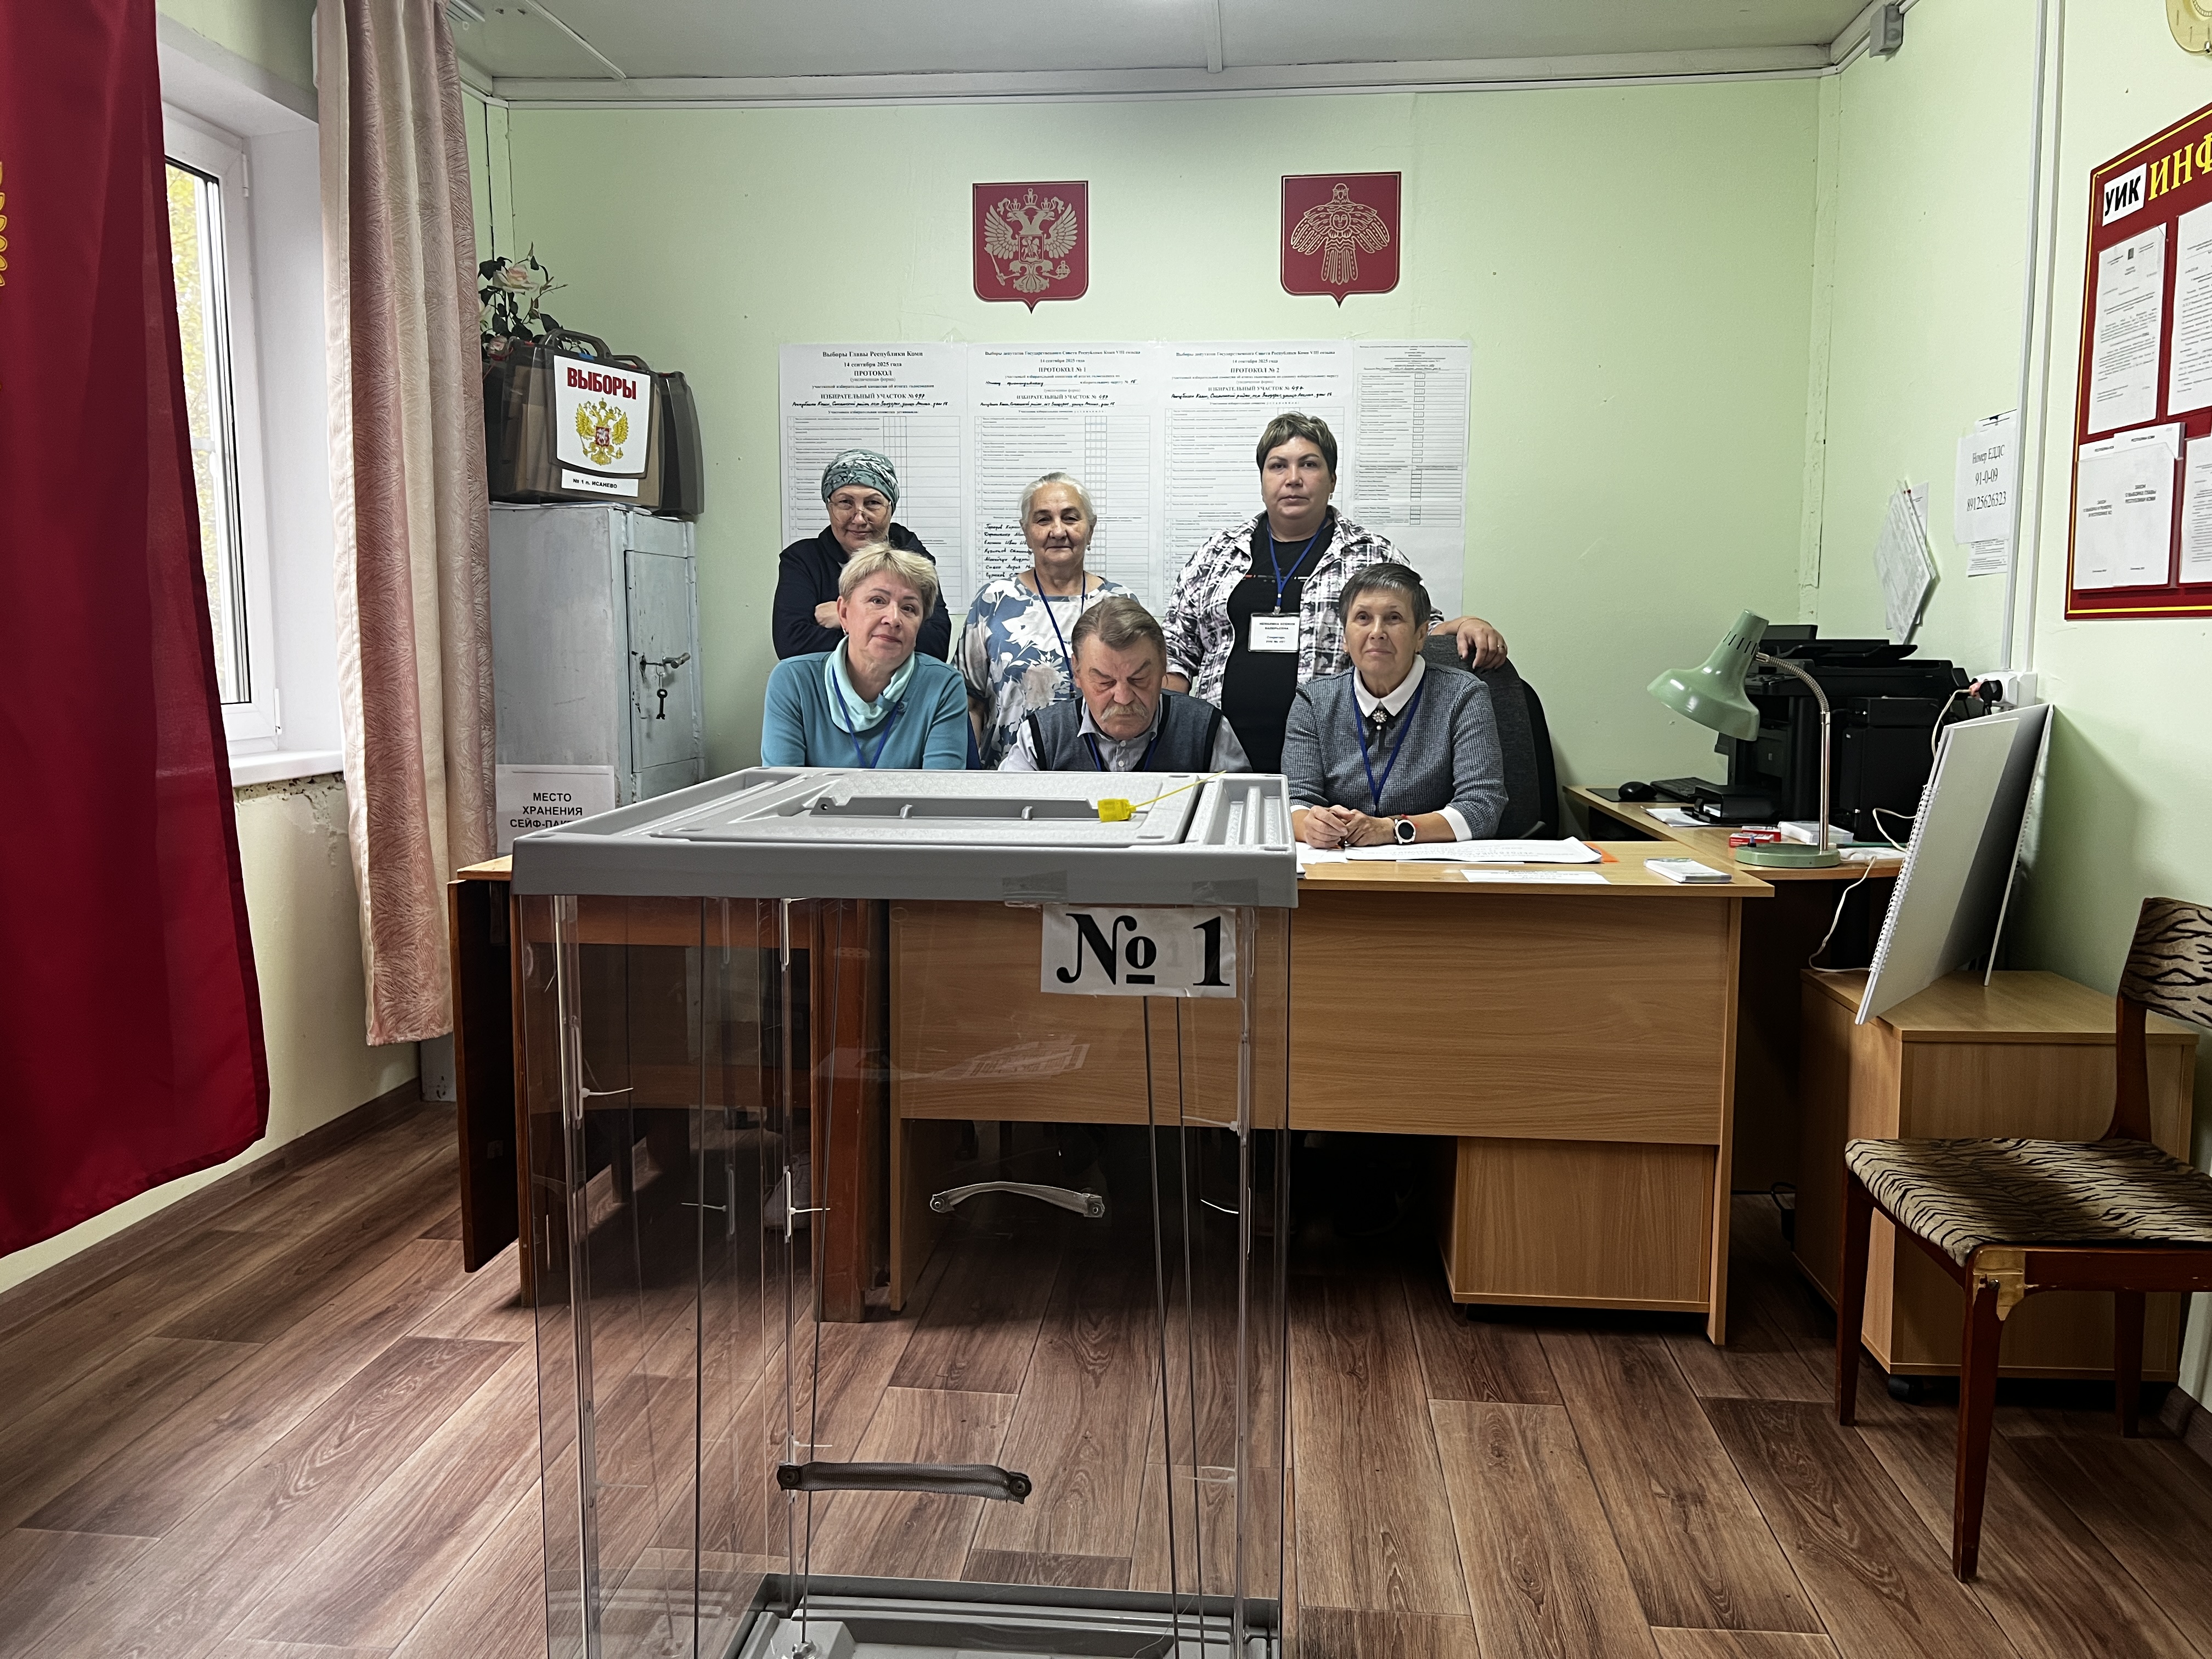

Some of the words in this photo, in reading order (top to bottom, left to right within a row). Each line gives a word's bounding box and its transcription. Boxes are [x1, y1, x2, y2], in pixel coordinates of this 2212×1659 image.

[2104, 175, 2141, 216] УИК
[2148, 132, 2212, 201] ИНФ
[567, 367, 636, 400] ВЫБОРЫ
[1972, 452, 1987, 464] Номер
[1988, 444, 2005, 460] ЕДДС
[1975, 468, 1998, 486] 91-0-09
[533, 793, 572, 802] МЕСТО
[523, 806, 582, 815] ХРАНЕНИЯ
[510, 817, 573, 828] СЕЙФ-ПА
[1056, 913, 1156, 985] №
[1193, 916, 1230, 986] 1
